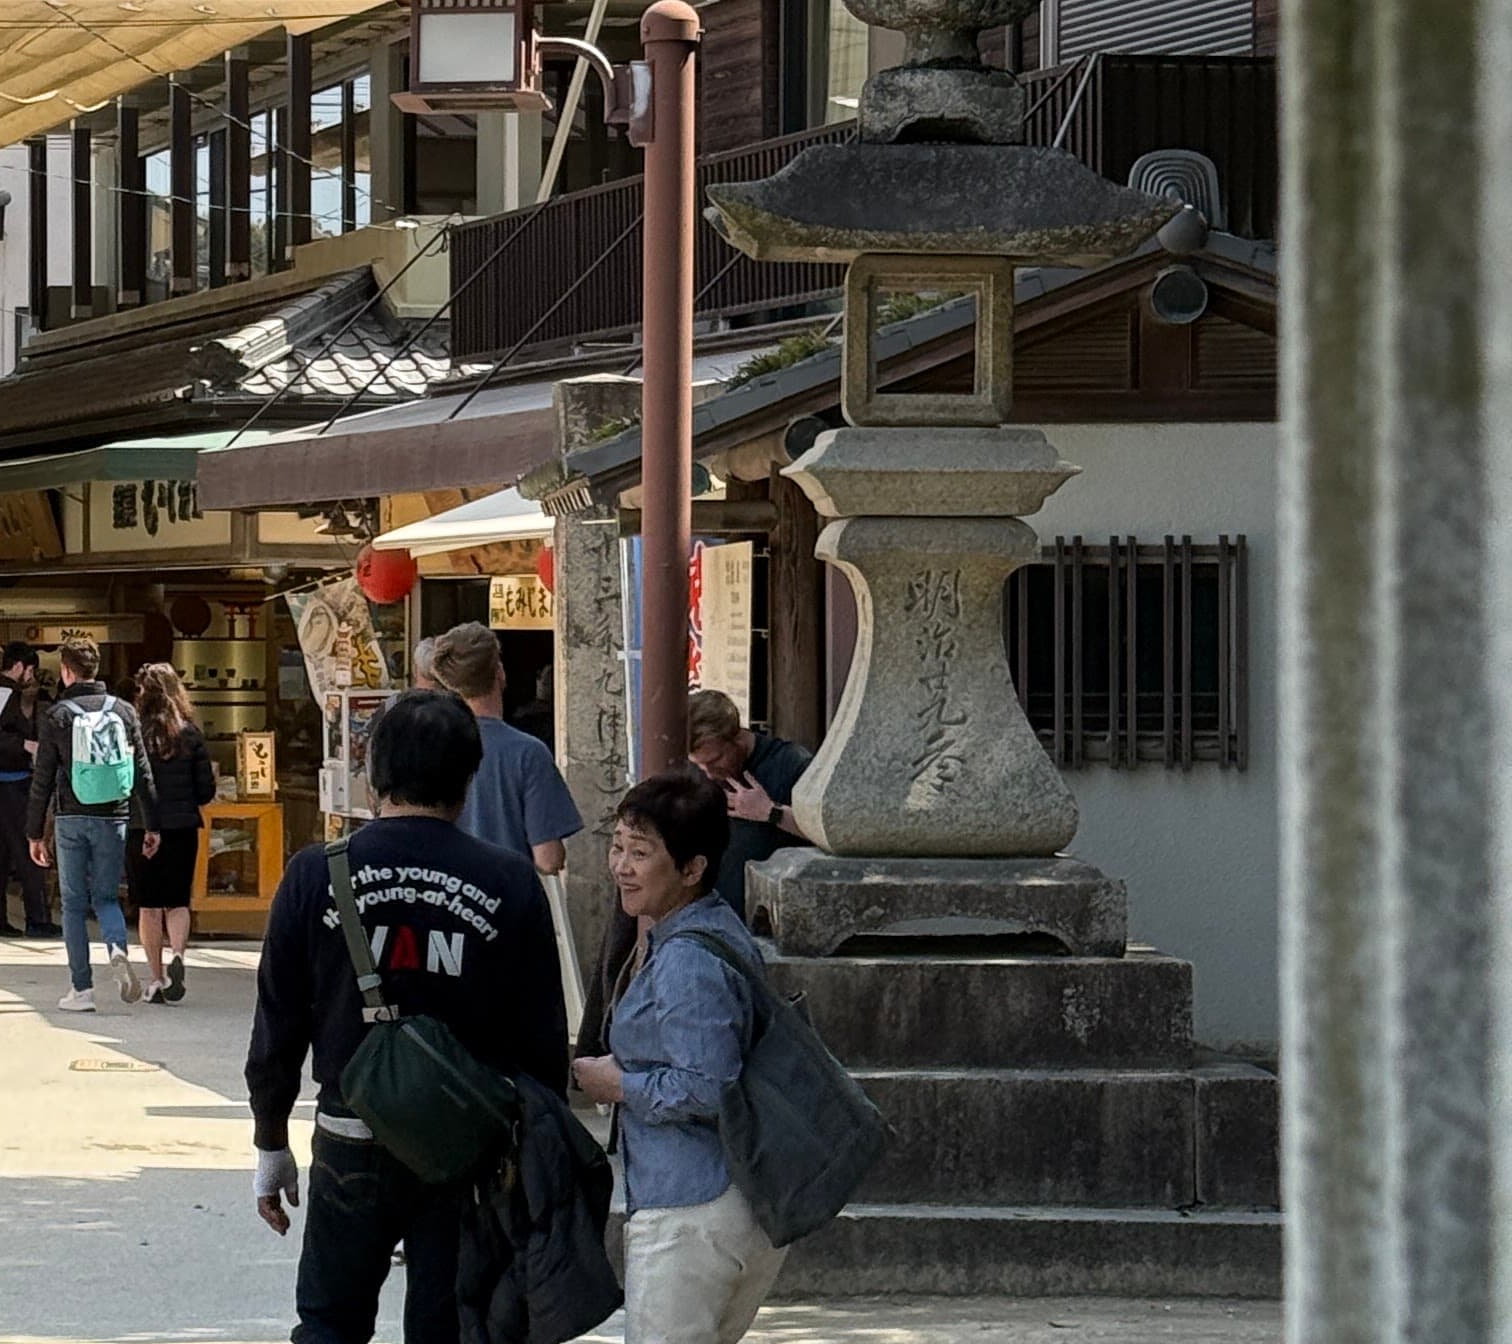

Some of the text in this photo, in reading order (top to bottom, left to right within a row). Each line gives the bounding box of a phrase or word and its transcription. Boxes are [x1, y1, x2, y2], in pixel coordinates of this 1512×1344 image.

[505, 584, 553, 618] もみじま
[357, 864, 502, 915] the young and
